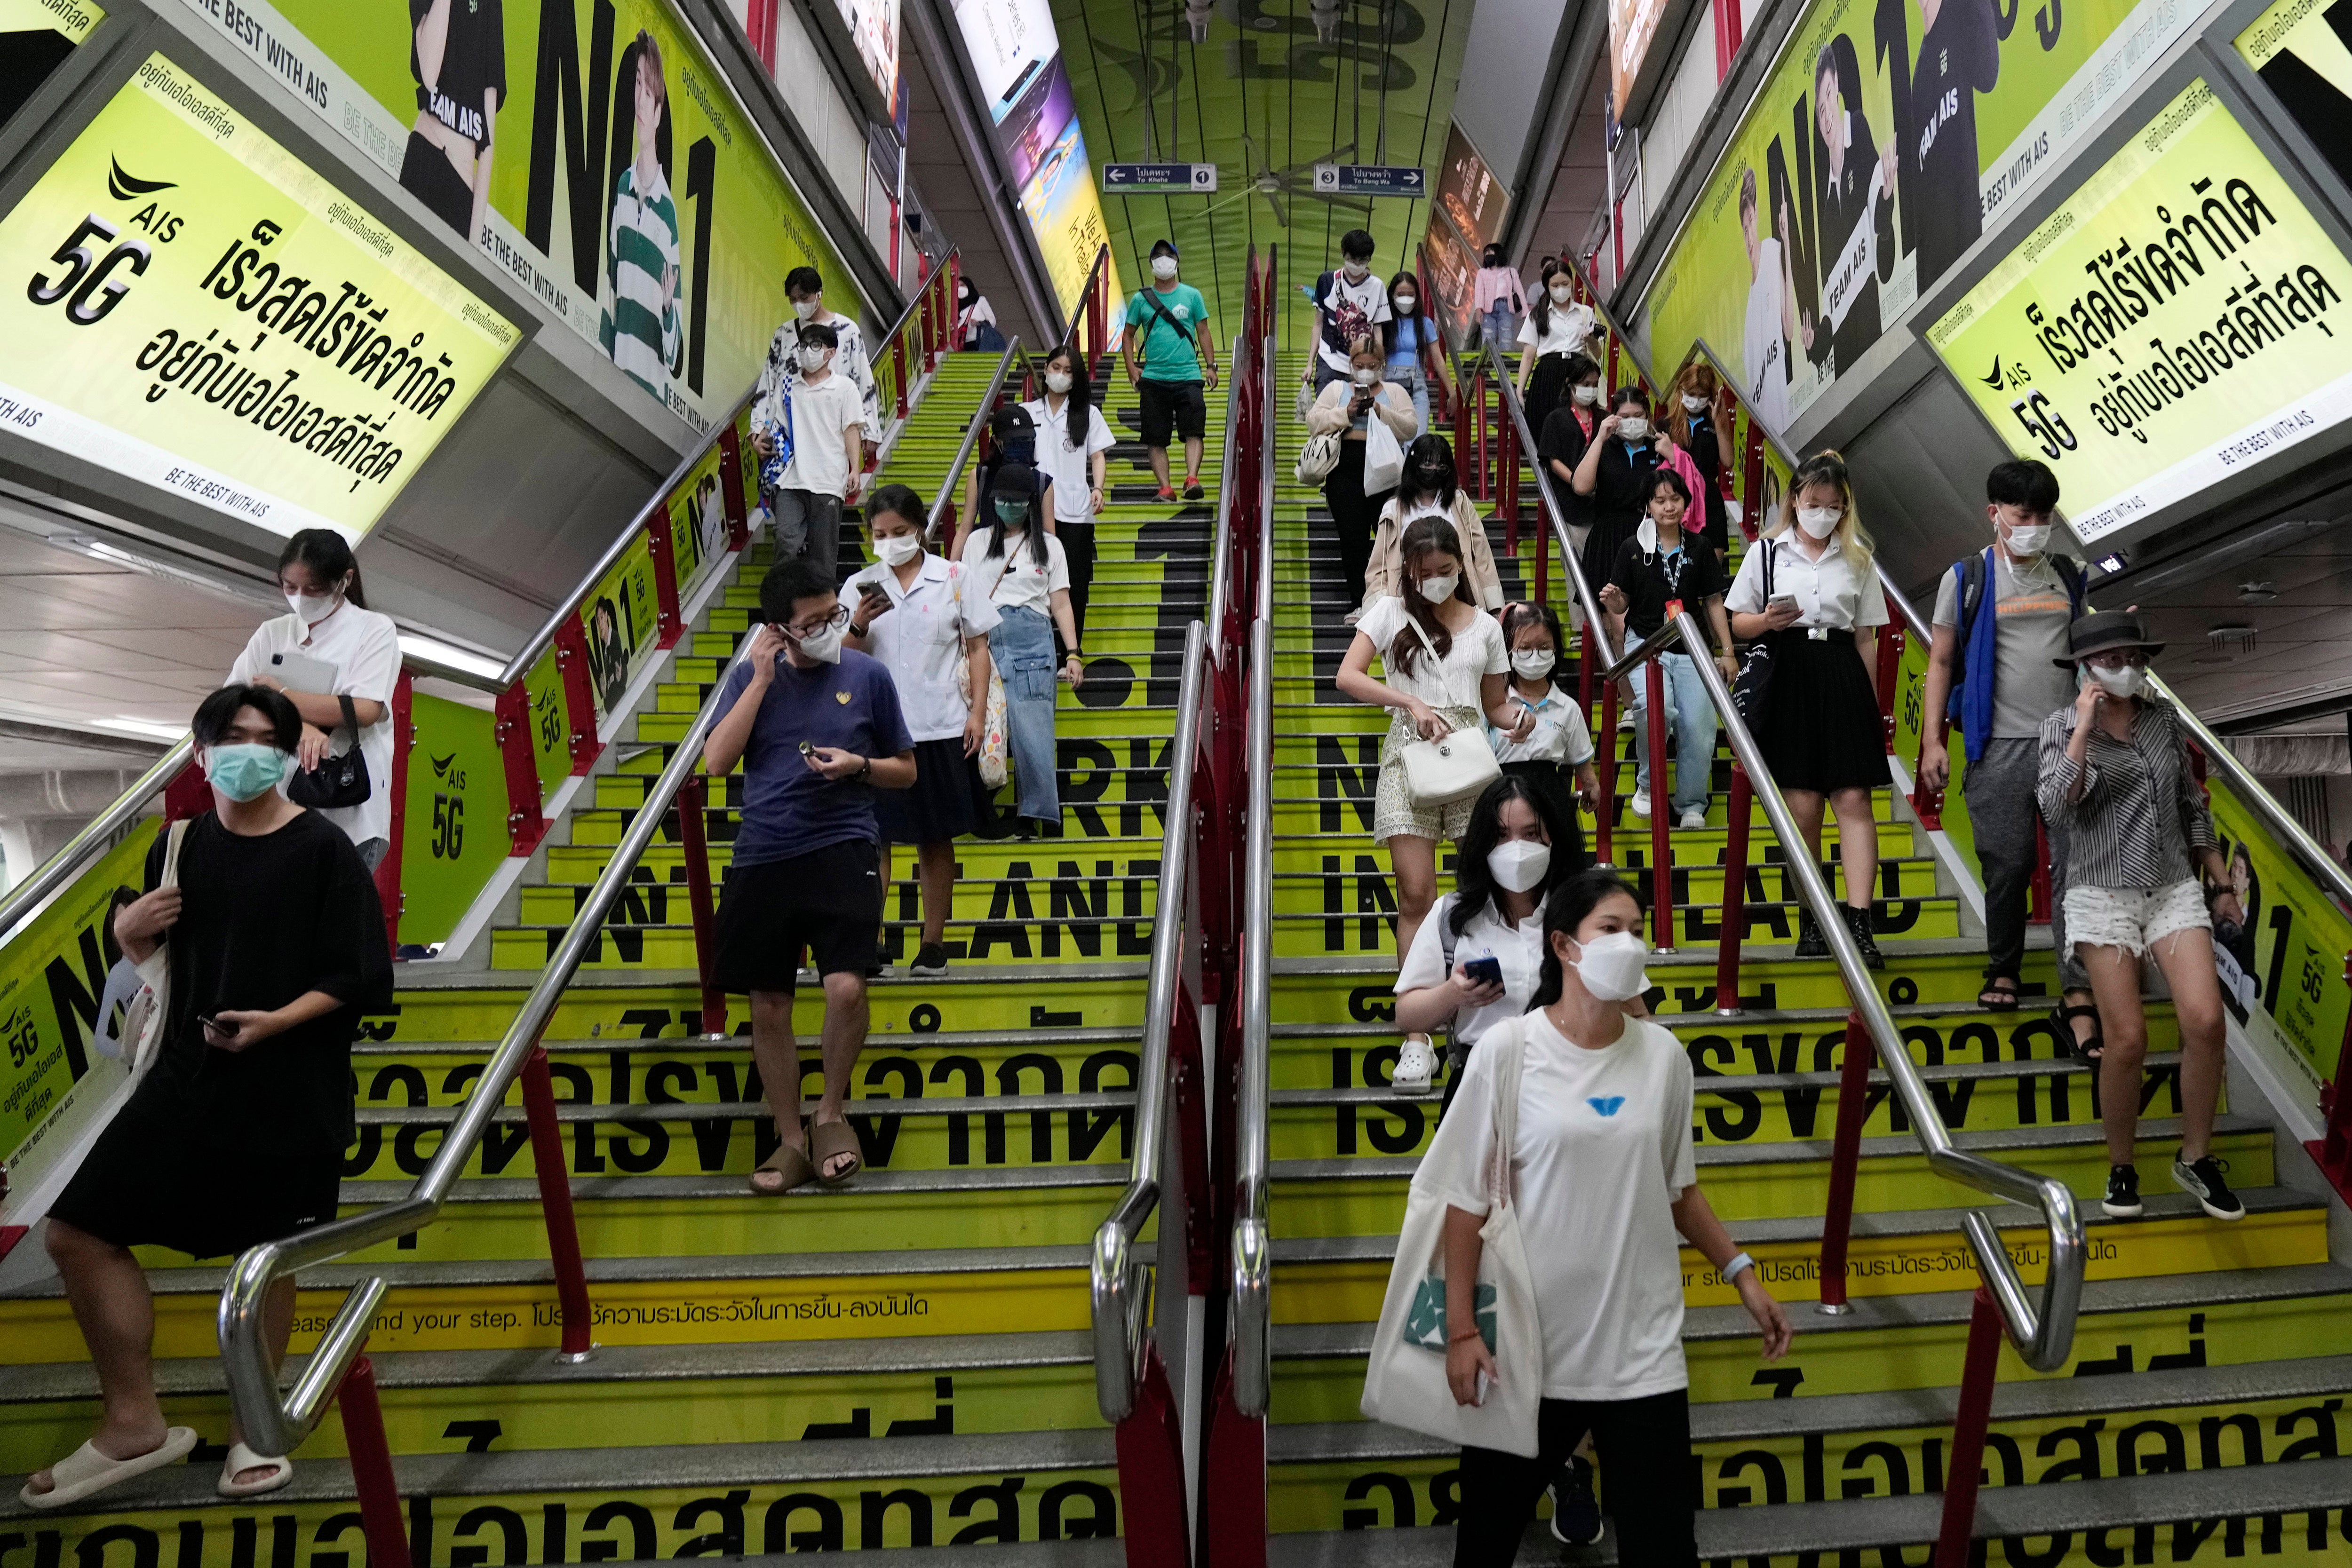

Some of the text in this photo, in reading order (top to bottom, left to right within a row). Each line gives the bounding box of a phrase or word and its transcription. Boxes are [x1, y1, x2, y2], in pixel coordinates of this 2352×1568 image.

[225, 0, 327, 109] BEST WITH AIS
[2095, 51, 2123, 102] BEST
[2124, 21, 2156, 71] WITH
[343, 101, 361, 139] BE
[364, 117, 386, 160] THE
[430, 87, 482, 141] EAM AIS
[1939, 87, 1957, 128] AIS
[1987, 174, 2007, 212] BEST
[2010, 147, 2032, 188] WITH
[2034, 130, 2049, 169] AIS
[130, 202, 184, 244] AIS
[1085, 206, 1097, 240] We
[27, 212, 152, 326] 5G
[481, 224, 567, 316] BE THE BEST WITH AIS
[1829, 238, 1866, 315] TEAM AIS
[2025, 177, 2278, 375] เร็วสุดไร้ขีดจำกัด
[199, 218, 457, 420] เร็วสุดไร้ขีดจำกัด
[1753, 339, 1778, 405] TEAM AIS
[1818, 365, 1826, 386] BE
[1825, 354, 1835, 381] THE
[2006, 362, 2032, 390] AIS
[2090, 261, 2342, 443] อยู่กับเอไอเอสดีที่สุด
[13, 408, 43, 427] AIS
[136, 328, 403, 493] อยู่กับเอไอเอสดีที่สุด
[673, 393, 686, 418] BEST
[687, 404, 700, 429] WITH
[2009, 388, 2078, 460] 5G
[2218, 410, 2314, 465] BE THE BEST WITH AIS
[165, 468, 270, 518] BE THE BEST WITH AIS
[2077, 495, 2146, 536] BE THE BEST WITH AIS
[636, 578, 644, 602] 5G
[1995, 601, 2068, 614] HILIPPINES
[547, 688, 556, 709] AIS
[1904, 688, 1920, 736] 5G
[1913, 682, 1922, 701] AIS
[540, 705, 561, 753] 5G
[448, 768, 466, 791] AIS
[432, 793, 463, 860] 5G
[2302, 960, 2323, 1004] 5G
[16, 1006, 31, 1027] AIS
[8, 1020, 39, 1069] 5G
[9, 1094, 74, 1170] BE THE BEST WITH AIS
[413, 1312, 461, 1335] your
[470, 1307, 522, 1331] step.
